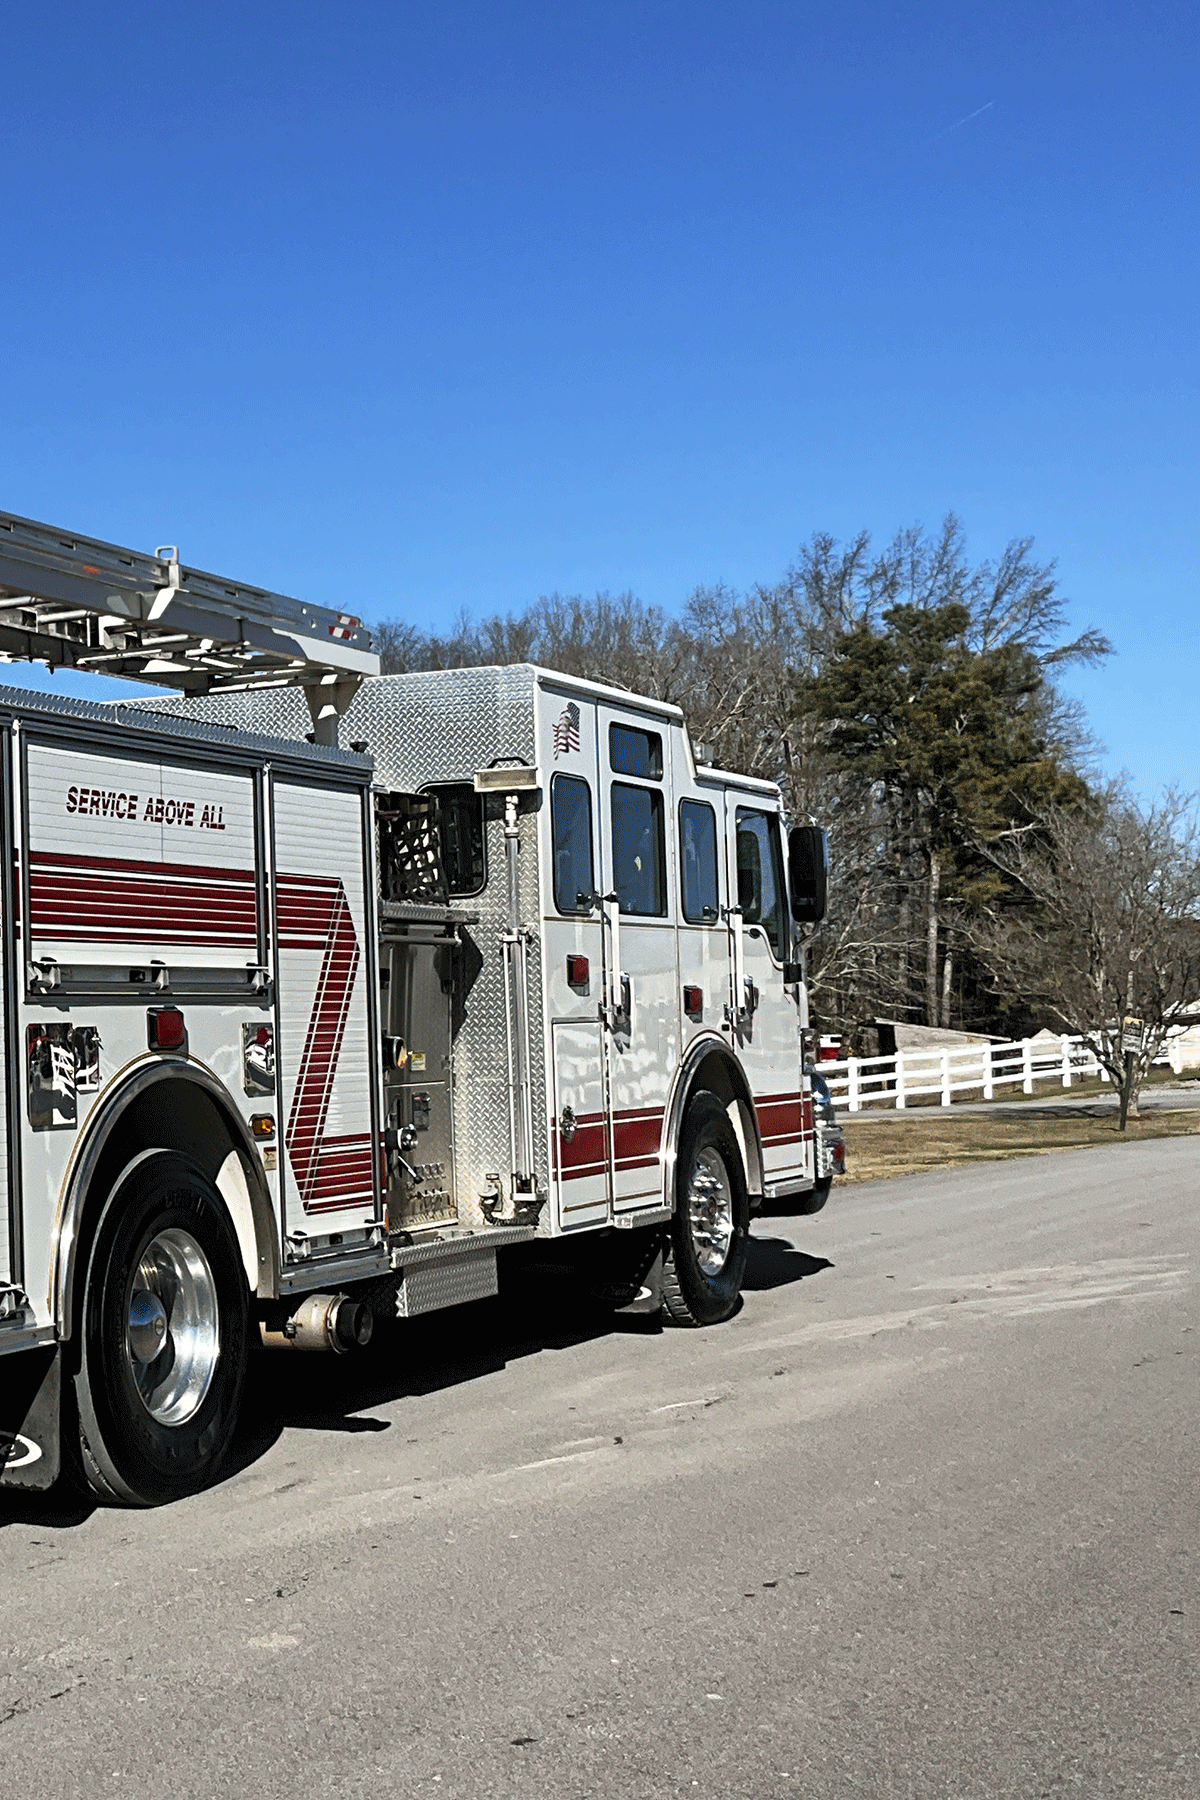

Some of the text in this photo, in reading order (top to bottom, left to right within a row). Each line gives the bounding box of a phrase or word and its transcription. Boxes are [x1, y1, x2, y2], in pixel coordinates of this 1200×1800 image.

[66, 786, 226, 830] SERVICE ABOVE ALL
